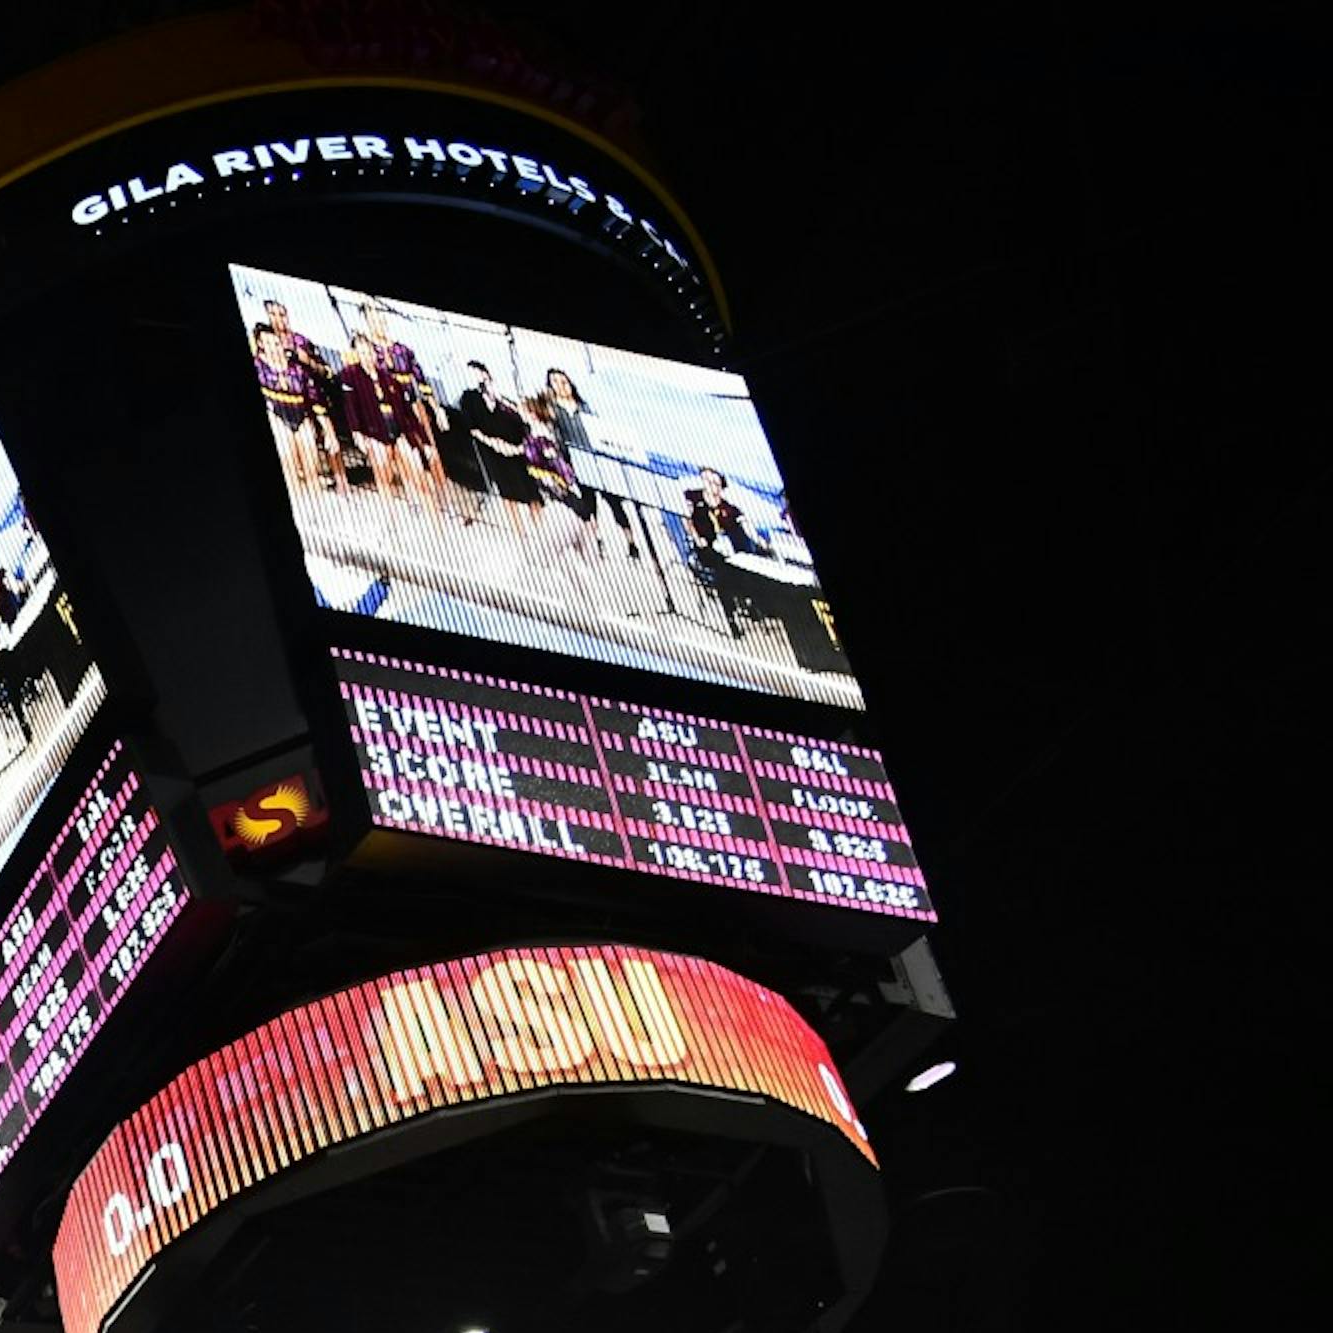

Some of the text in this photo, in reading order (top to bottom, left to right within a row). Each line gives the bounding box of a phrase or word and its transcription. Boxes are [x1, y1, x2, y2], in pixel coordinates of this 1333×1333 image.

[71, 135, 633, 225] GILA RIVER HOTELS &
[353, 697, 498, 753] EVENT
[366, 743, 517, 798] SCORE
[377, 789, 585, 854] OVERALL
[380, 958, 688, 1103] ASU
[103, 1142, 191, 1256] 0.0
